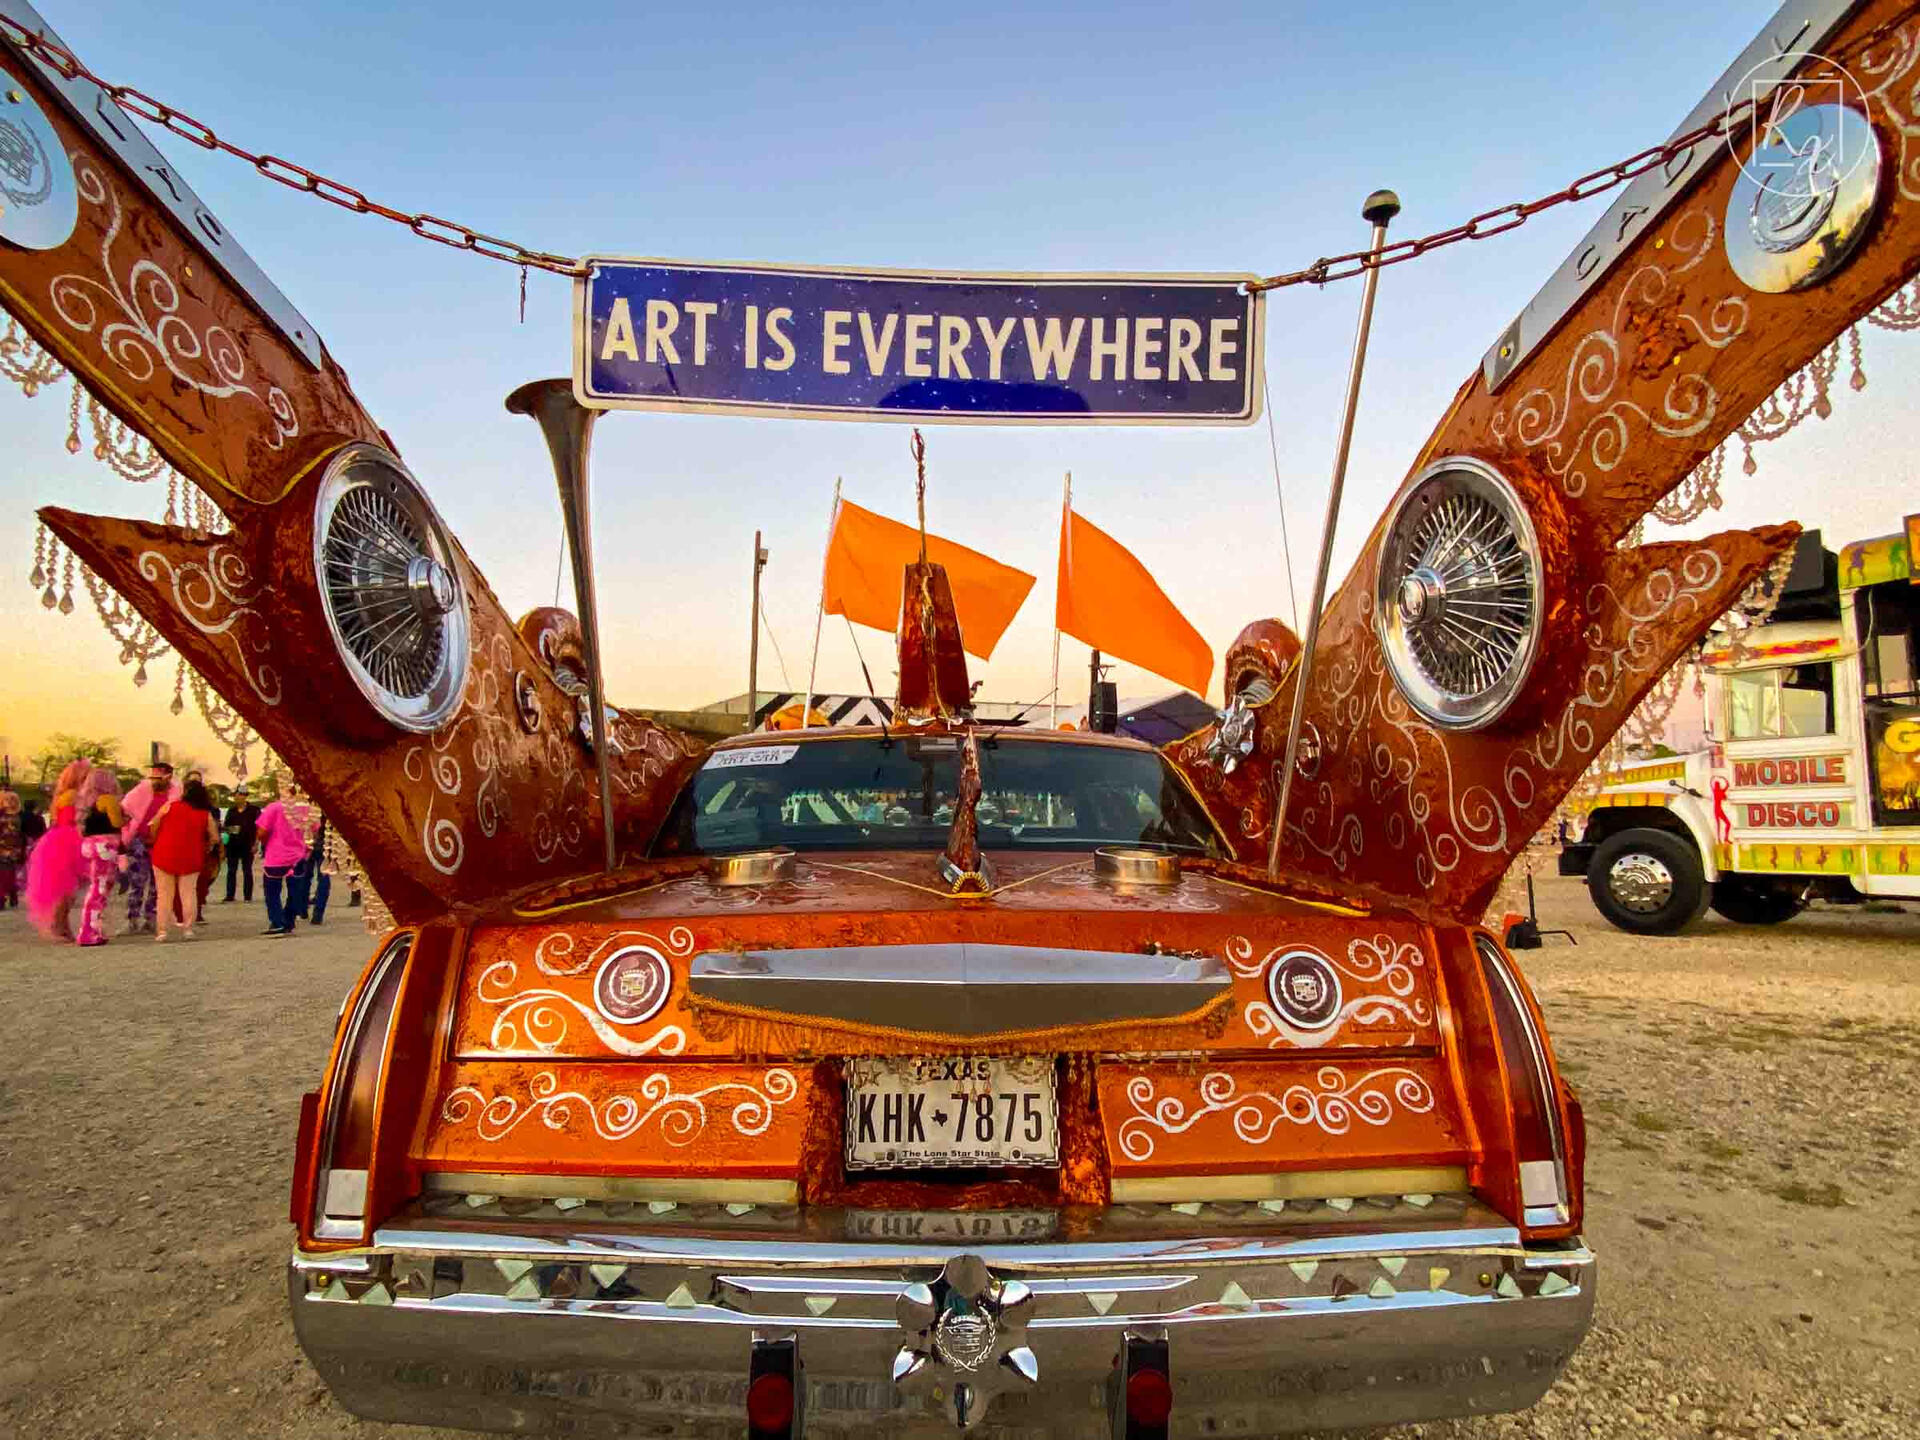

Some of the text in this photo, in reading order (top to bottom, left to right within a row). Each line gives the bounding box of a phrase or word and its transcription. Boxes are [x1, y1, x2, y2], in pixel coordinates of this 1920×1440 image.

[601, 297, 1239, 382] ART IS EVERYWHERE
[1734, 756, 1846, 787] MOBILE
[1747, 801, 1840, 828] DISCO
[858, 1093, 1043, 1143] KHK 7875
[902, 1150, 1000, 1158] The Lone Star State
